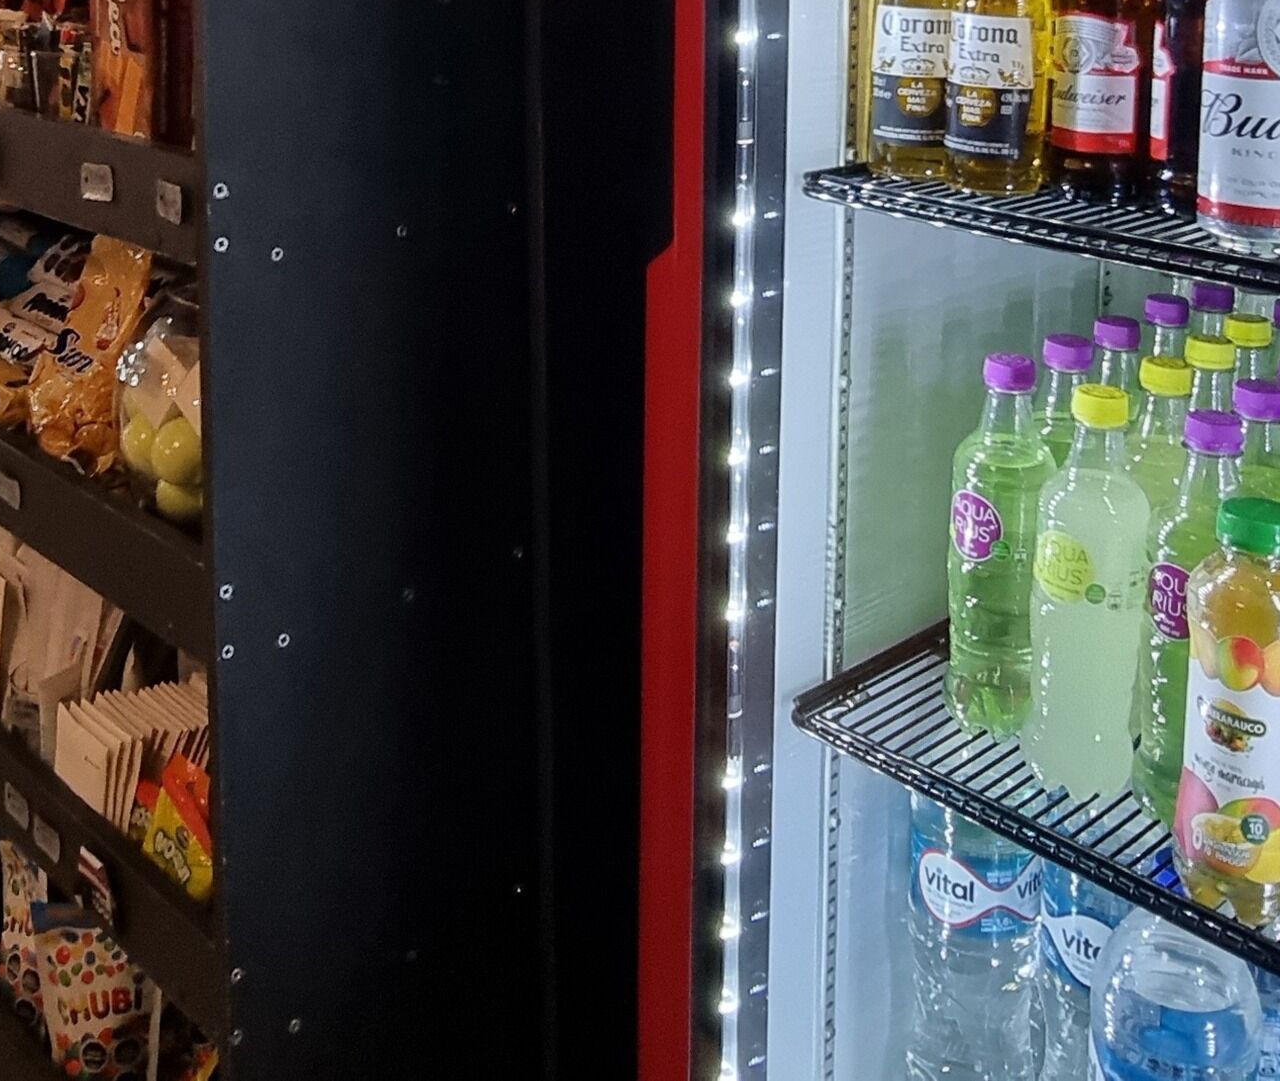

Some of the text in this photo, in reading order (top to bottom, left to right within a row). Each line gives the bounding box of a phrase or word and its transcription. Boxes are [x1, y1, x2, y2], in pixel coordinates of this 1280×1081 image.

[900, 36, 945, 53] Extra
[958, 42, 1000, 63] Extra
[1248, 822, 1264, 836] 10
[924, 865, 975, 903] vital
